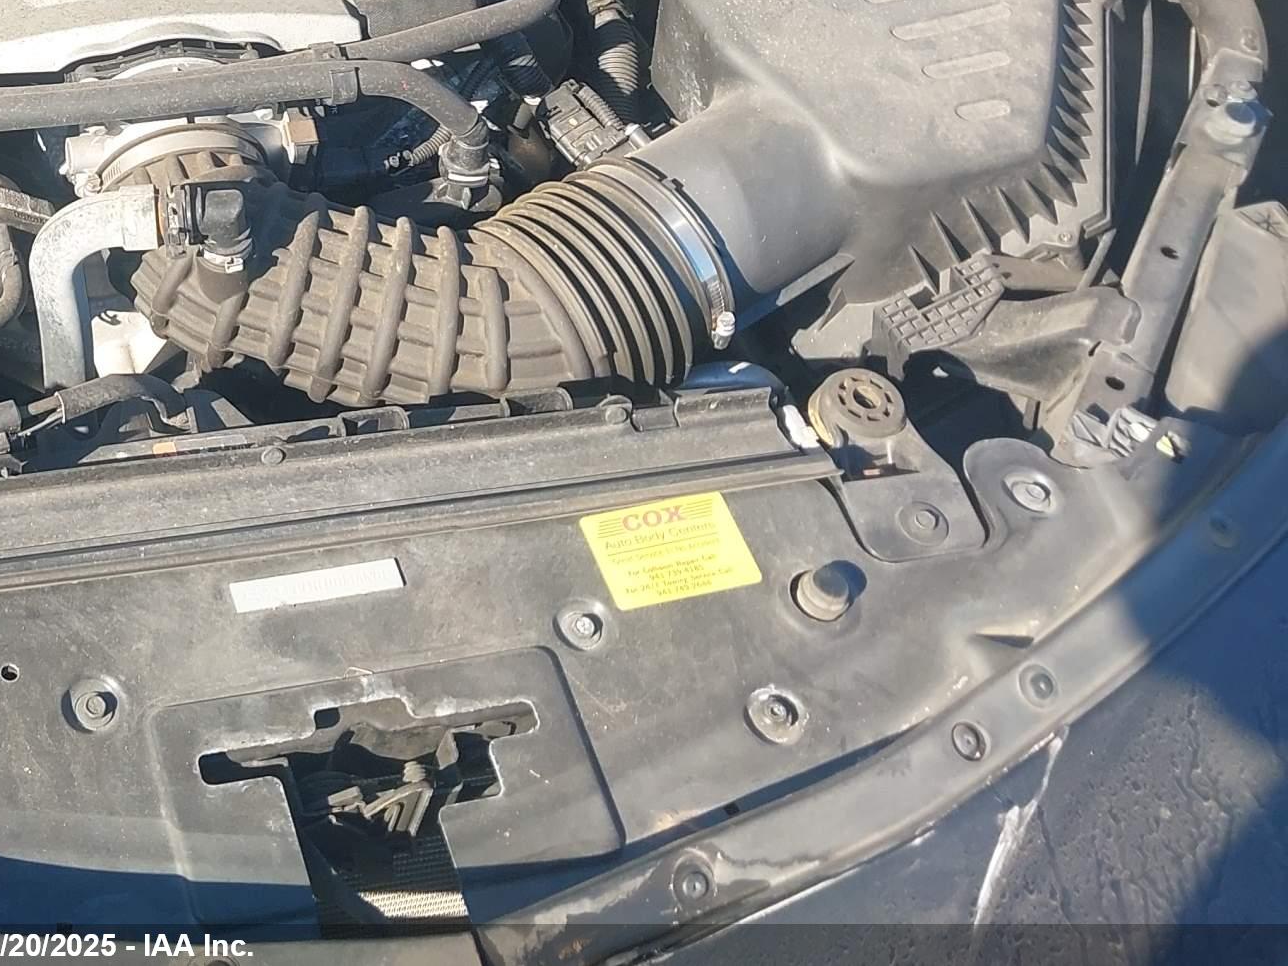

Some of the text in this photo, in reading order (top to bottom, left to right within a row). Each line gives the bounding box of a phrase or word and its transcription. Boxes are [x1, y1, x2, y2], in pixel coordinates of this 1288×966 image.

[622, 505, 687, 531] COX
[605, 539, 632, 550] Auto
[635, 532, 664, 545] Body
